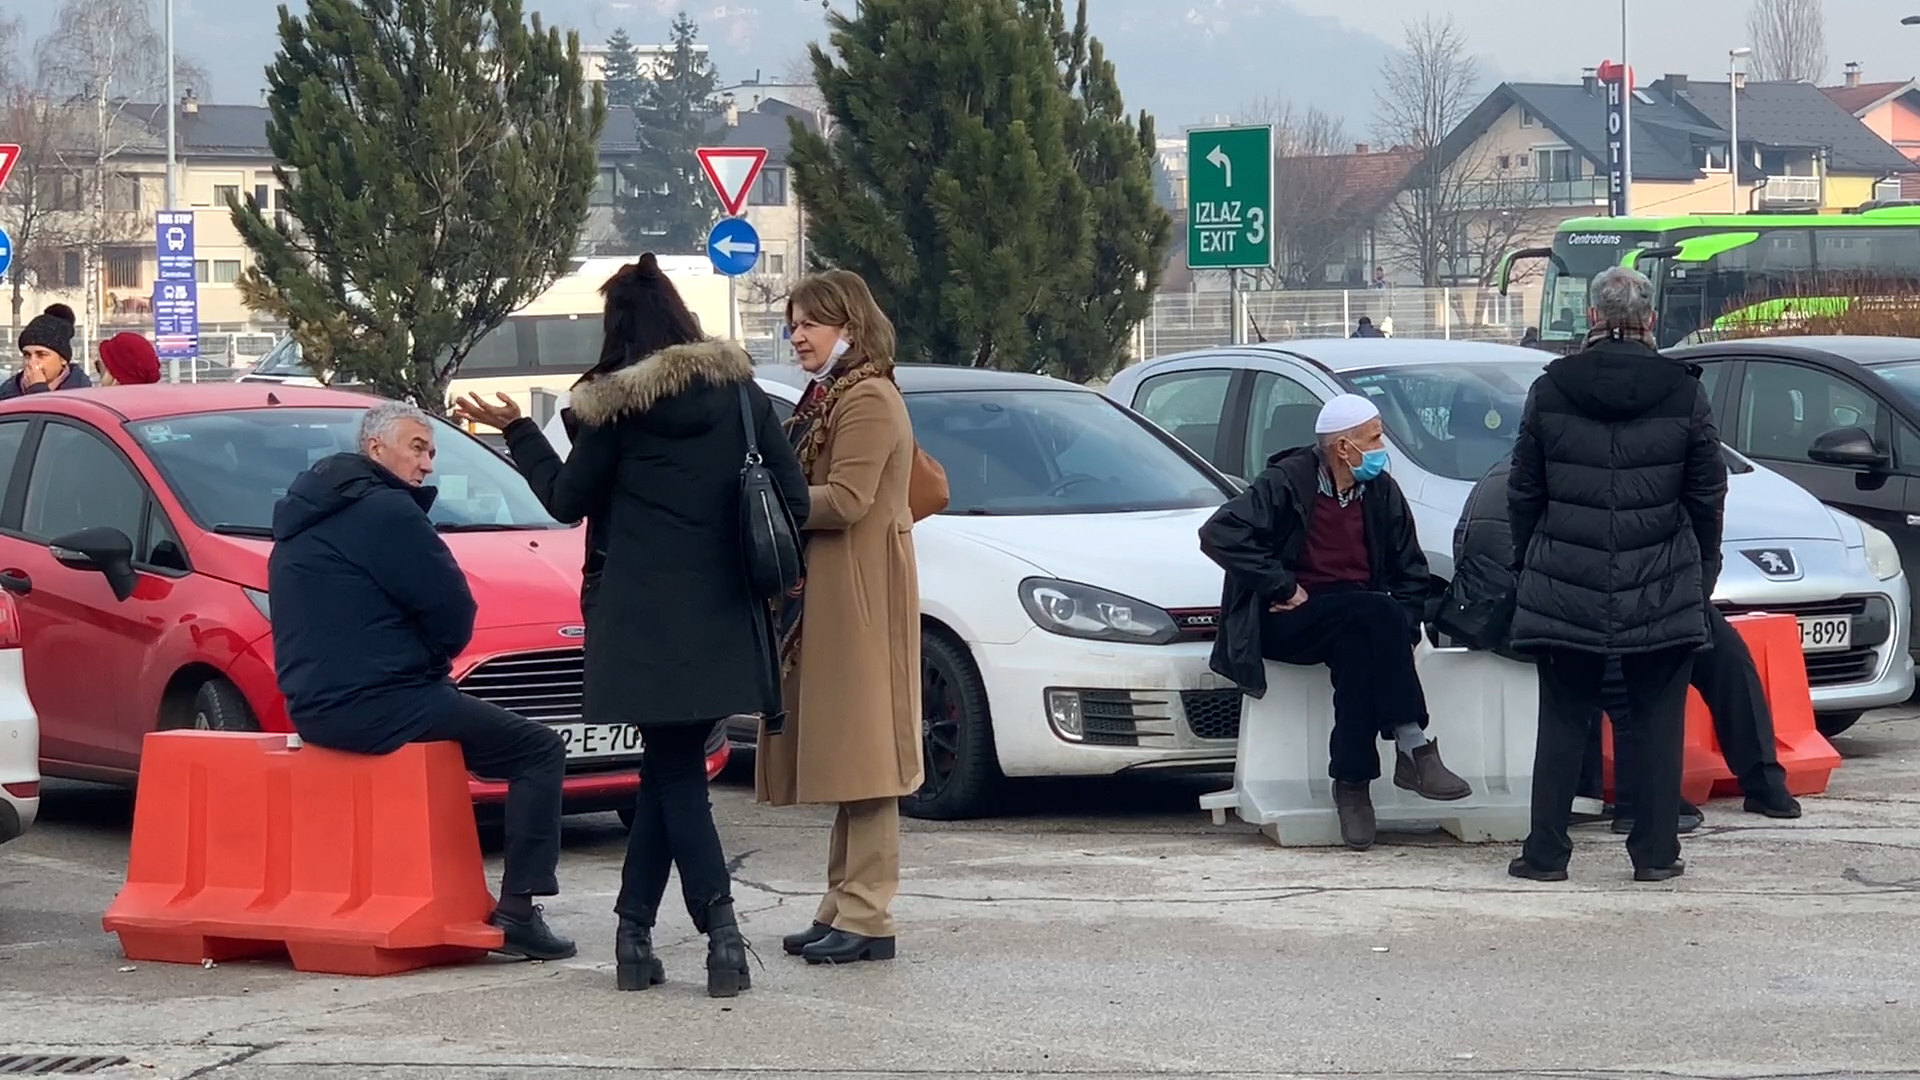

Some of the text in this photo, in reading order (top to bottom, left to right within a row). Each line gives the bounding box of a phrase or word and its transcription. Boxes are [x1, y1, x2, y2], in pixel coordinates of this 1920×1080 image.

[158, 213, 192, 224] BUS STOP
[1196, 201, 1241, 223] IZLAZ
[1246, 206, 1265, 245] 3
[1200, 230, 1237, 252] EXIT
[1568, 232, 1621, 245] Centrotrans
[554, 723, 644, 754] 2-E-70
